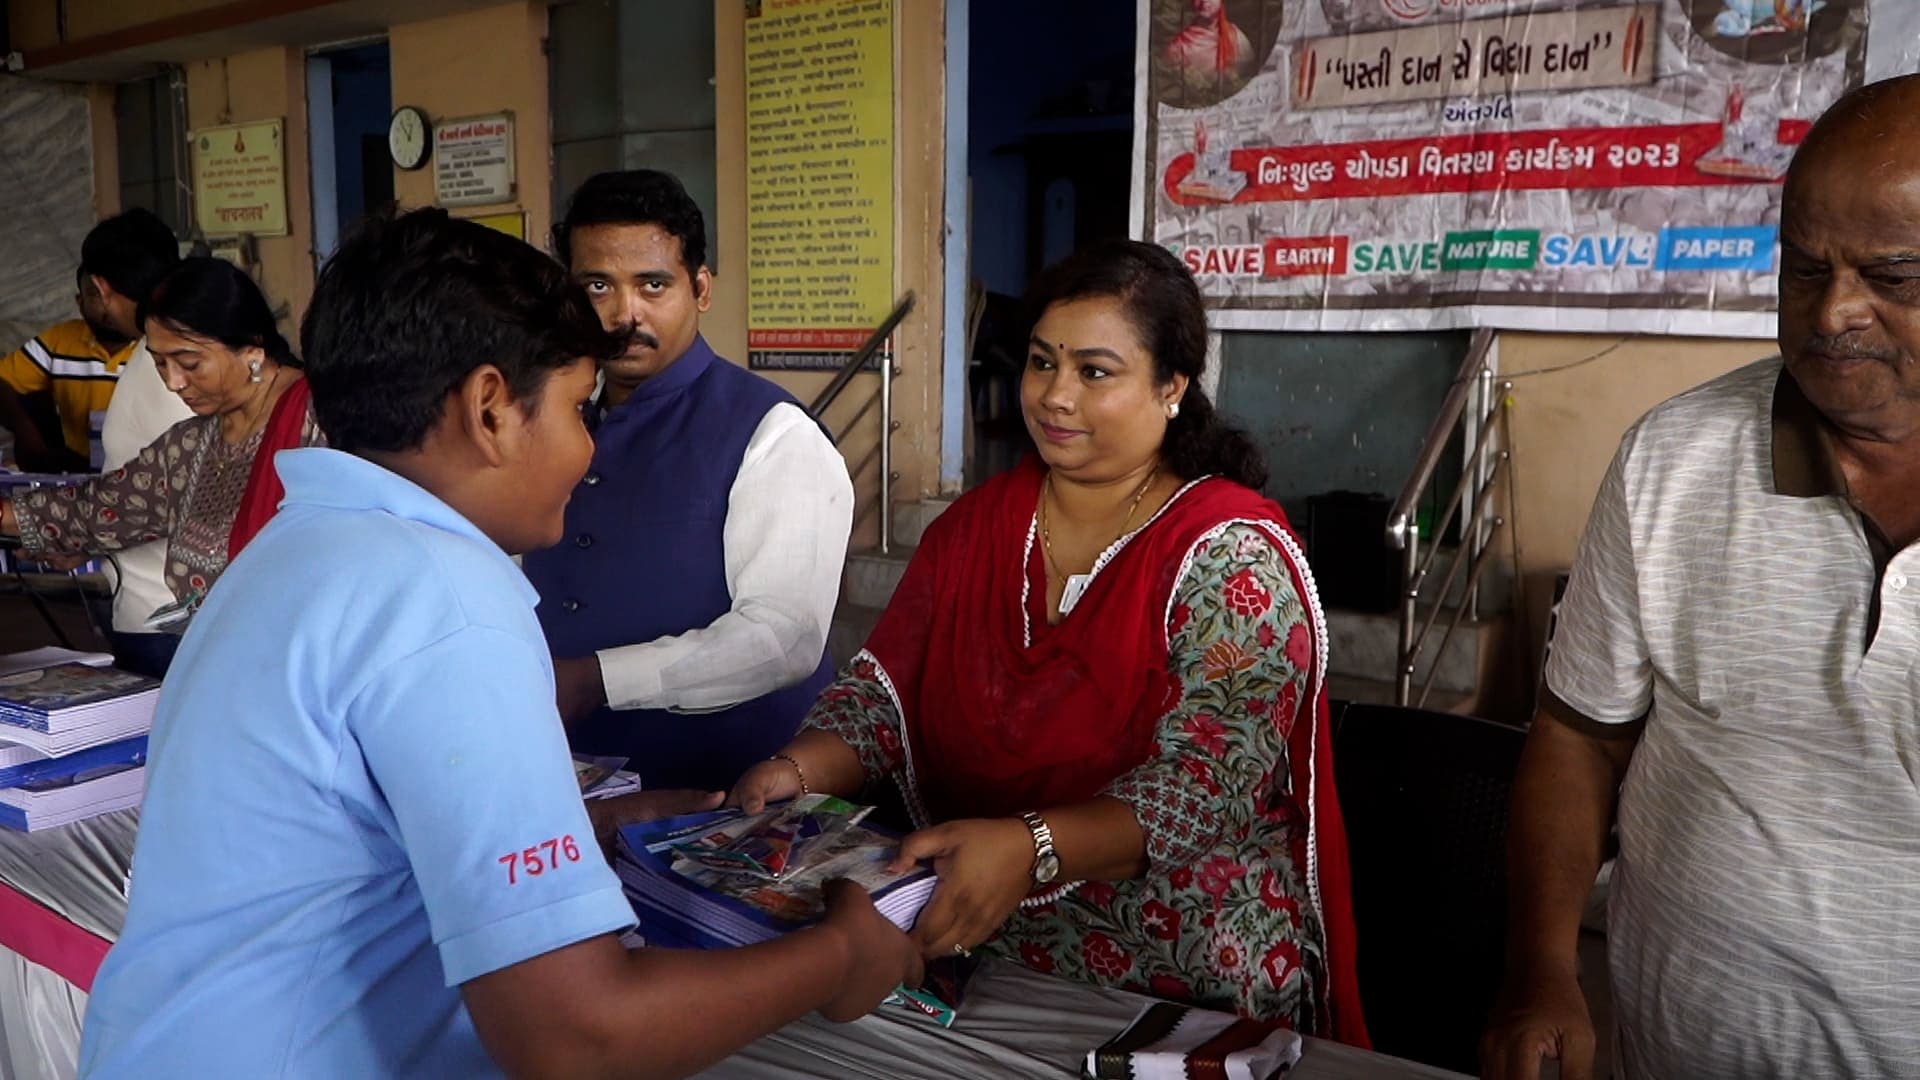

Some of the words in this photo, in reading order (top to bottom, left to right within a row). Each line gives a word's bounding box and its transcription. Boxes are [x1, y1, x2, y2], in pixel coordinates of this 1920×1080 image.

[1402, 54, 1442, 85] દાન
[1452, 37, 1471, 80] સે
[1445, 97, 1513, 122] અંતર્ગત
[1345, 149, 1409, 180] ચોપડા
[1418, 146, 1494, 177] વિતરણ
[1505, 136, 1595, 172] કાર્યક્રમ
[1609, 143, 1680, 168] ૨૦૨૩
[1184, 247, 1261, 275] SAVE
[1275, 247, 1335, 266] EARTH
[1353, 242, 1438, 273] SAVE
[1447, 239, 1530, 261] NATURE
[1673, 237, 1755, 259] PAPER
[498, 833, 581, 885] 7576
